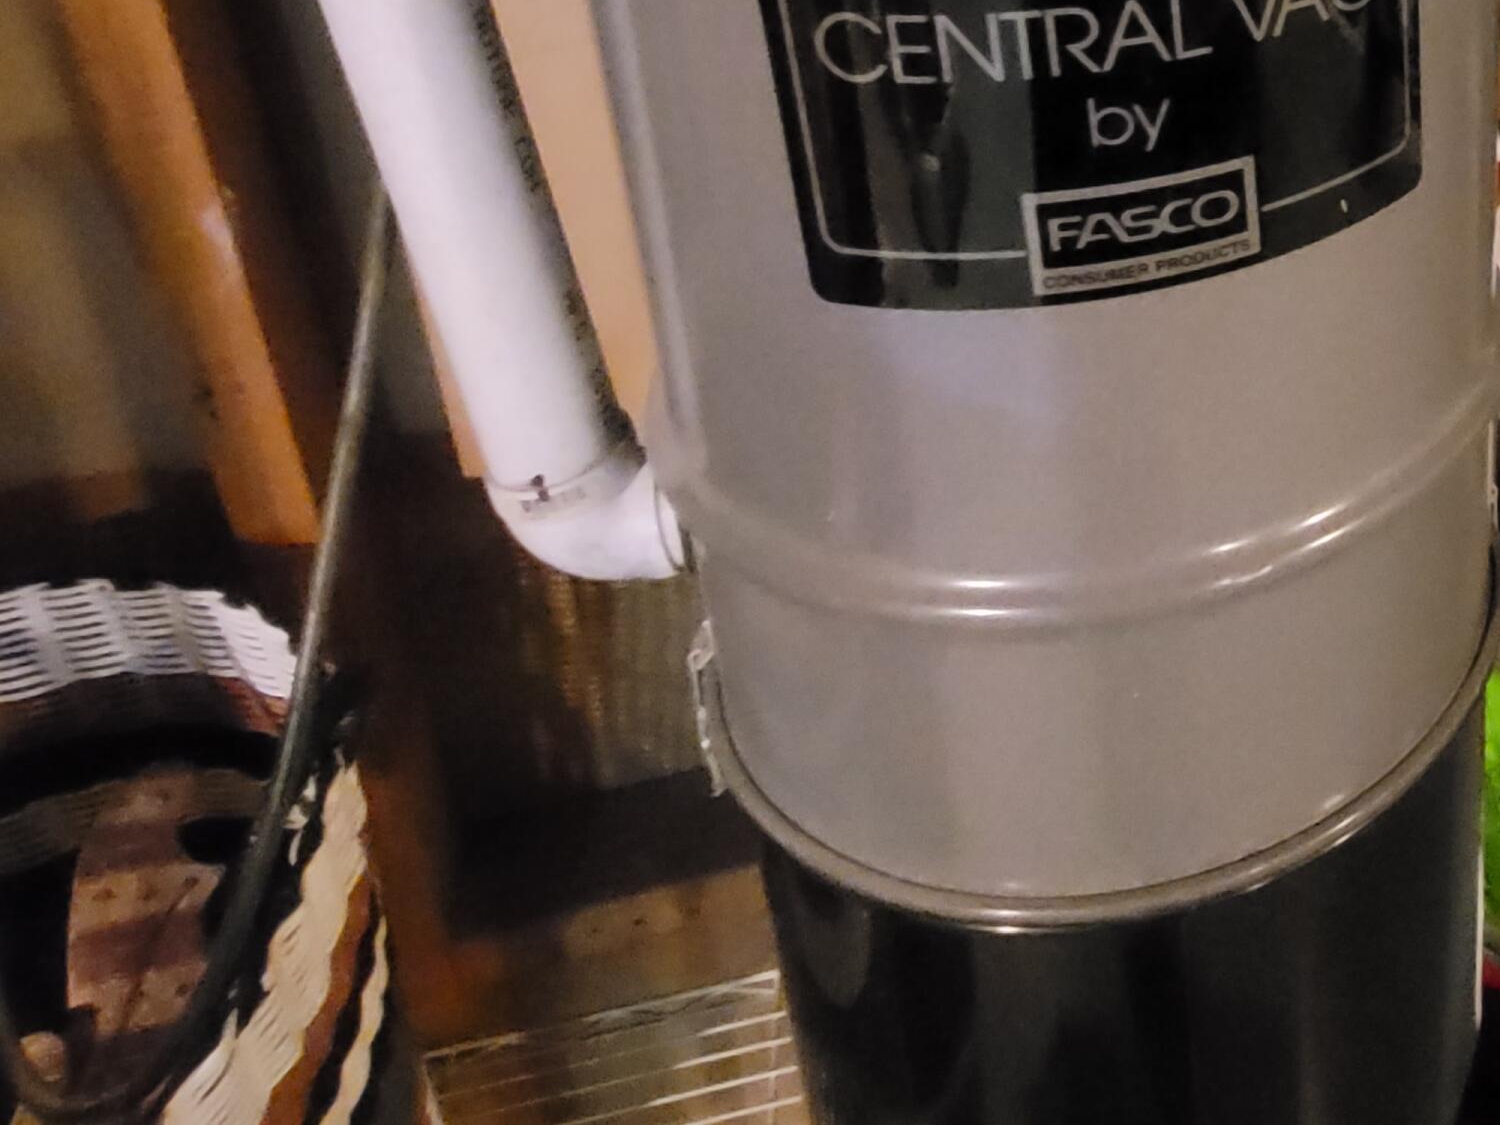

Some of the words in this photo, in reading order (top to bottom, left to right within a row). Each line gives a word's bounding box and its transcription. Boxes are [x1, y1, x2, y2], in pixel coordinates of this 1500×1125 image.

[1087, 97, 1171, 152] by
[1047, 189, 1240, 252] FASCO
[1042, 262, 1149, 290] CONSUMER
[1154, 238, 1250, 272] PRODUCTS
